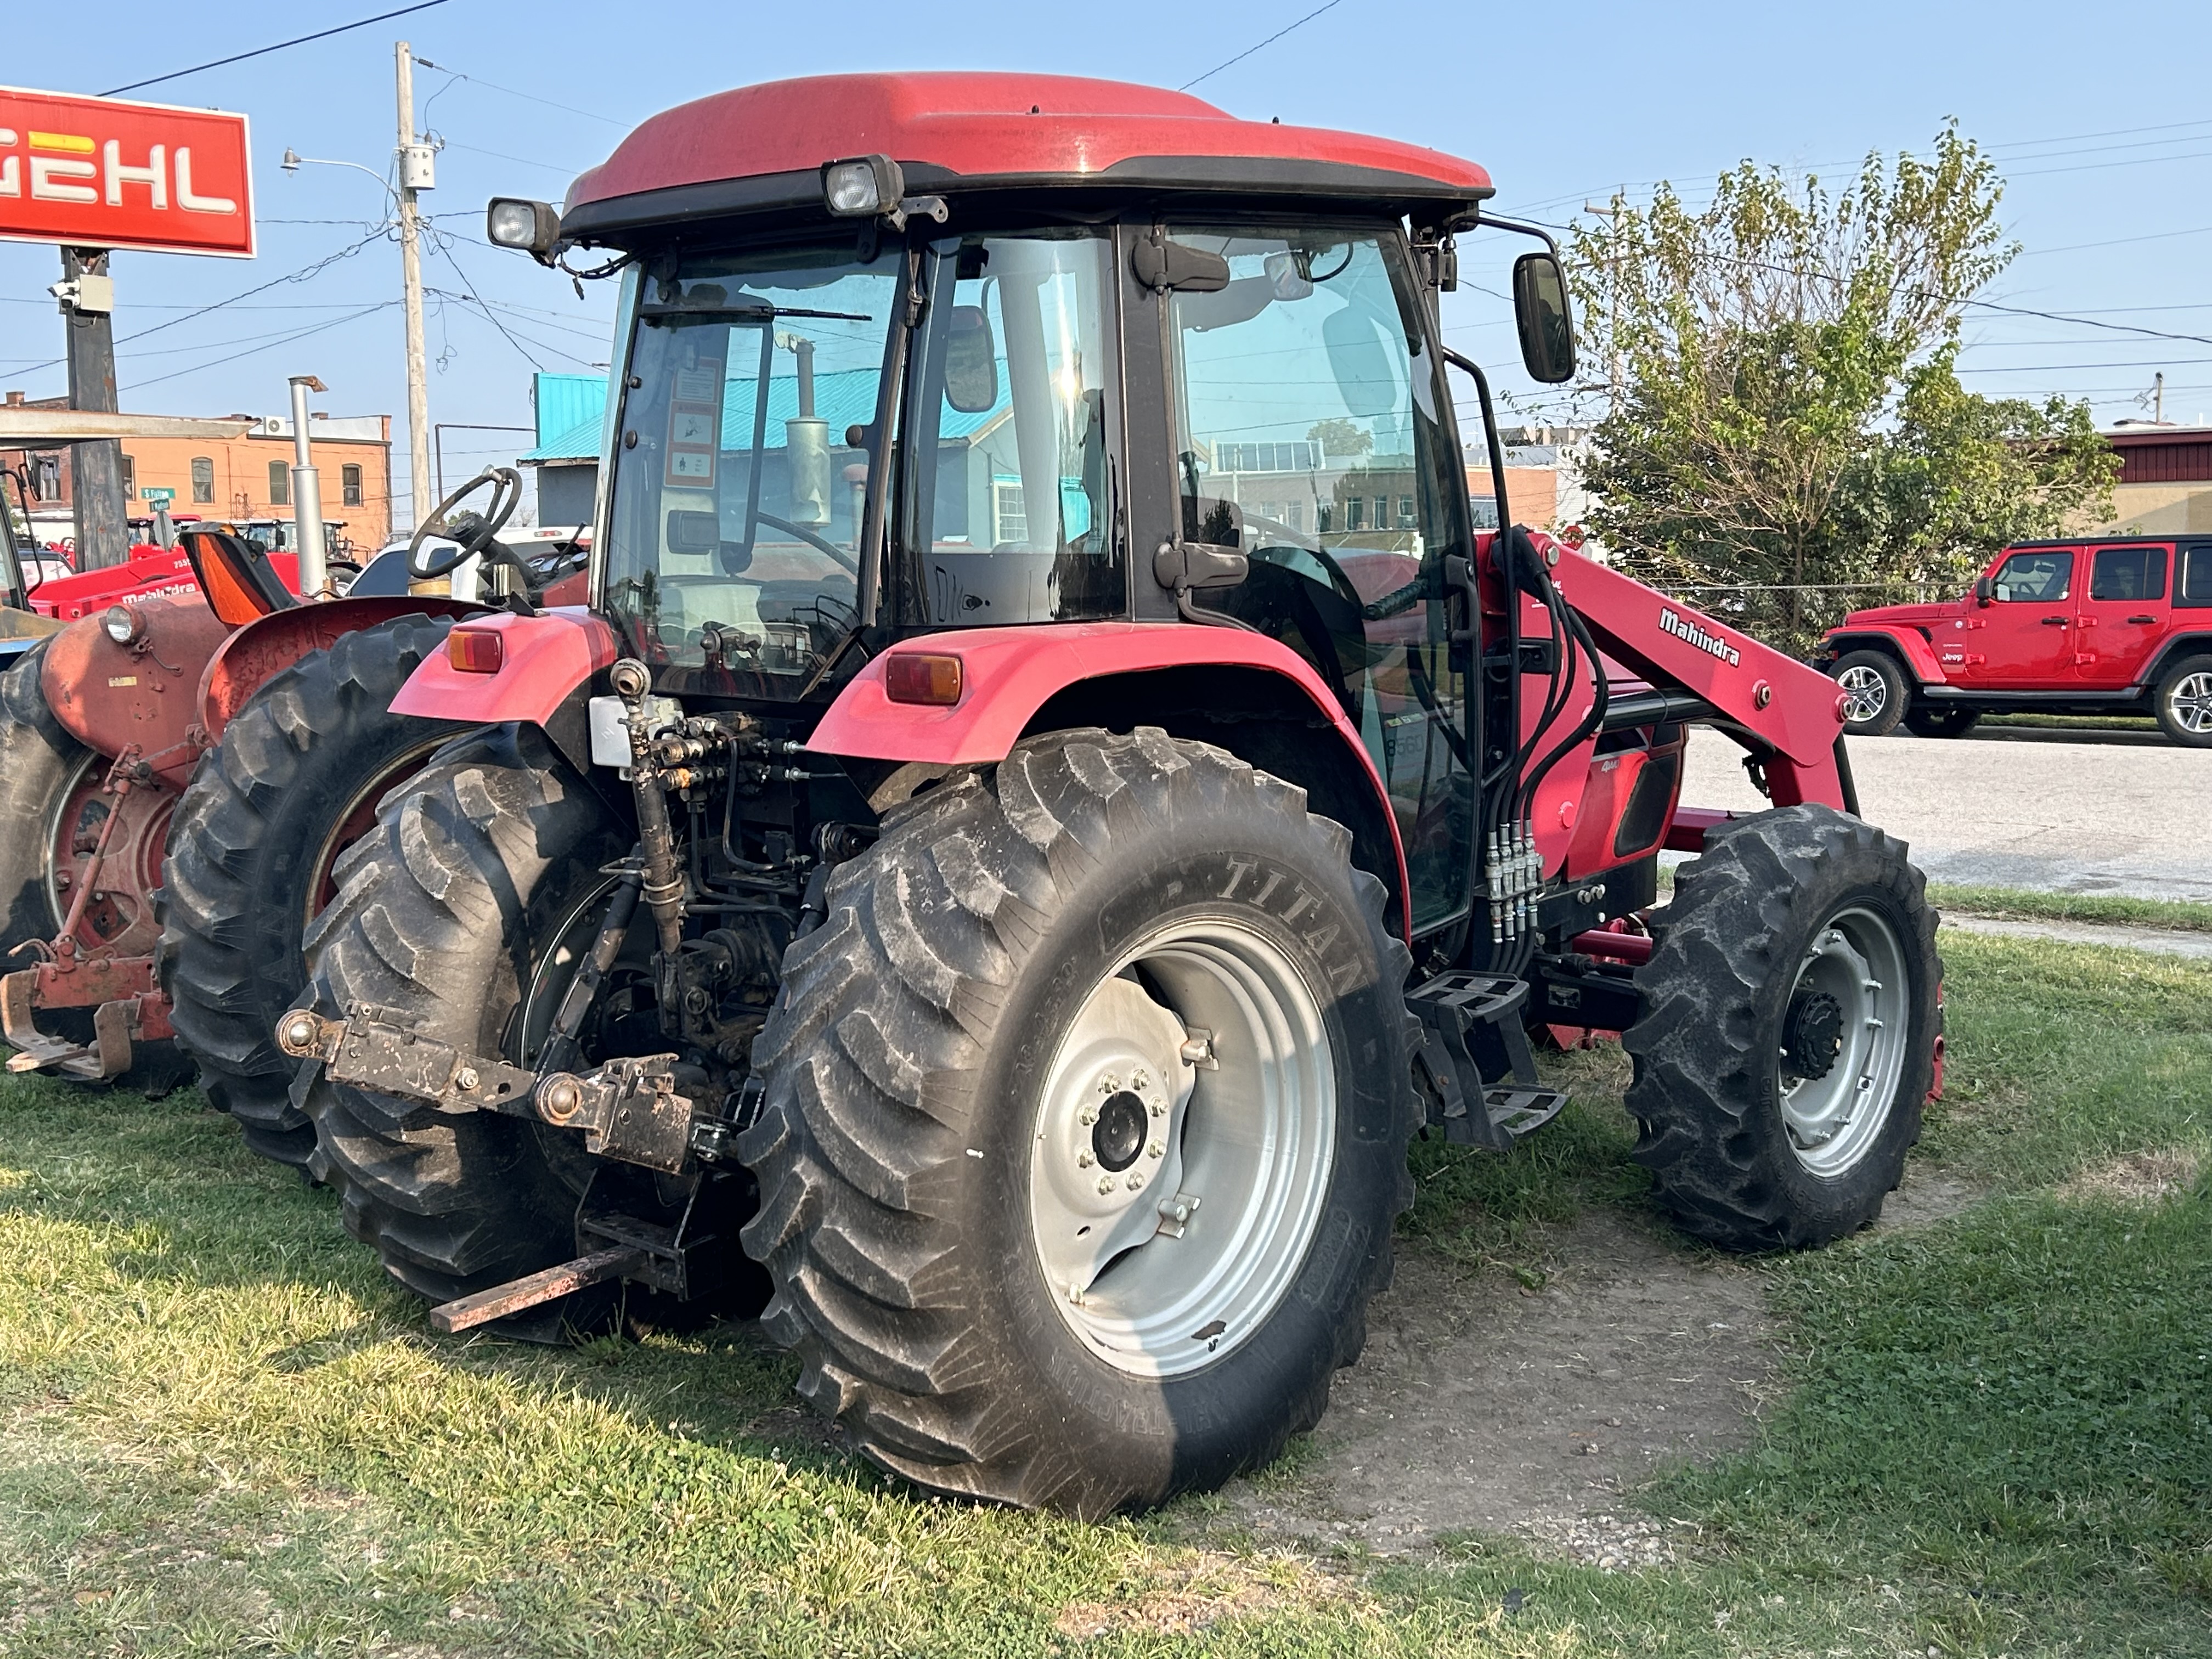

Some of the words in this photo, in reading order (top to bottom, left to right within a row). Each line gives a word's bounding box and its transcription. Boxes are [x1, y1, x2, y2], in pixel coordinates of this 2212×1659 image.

[1658, 607, 1740, 667] Mahindra
[1942, 653, 1963, 662] Jeep
[1216, 856, 1370, 997] TITAN
